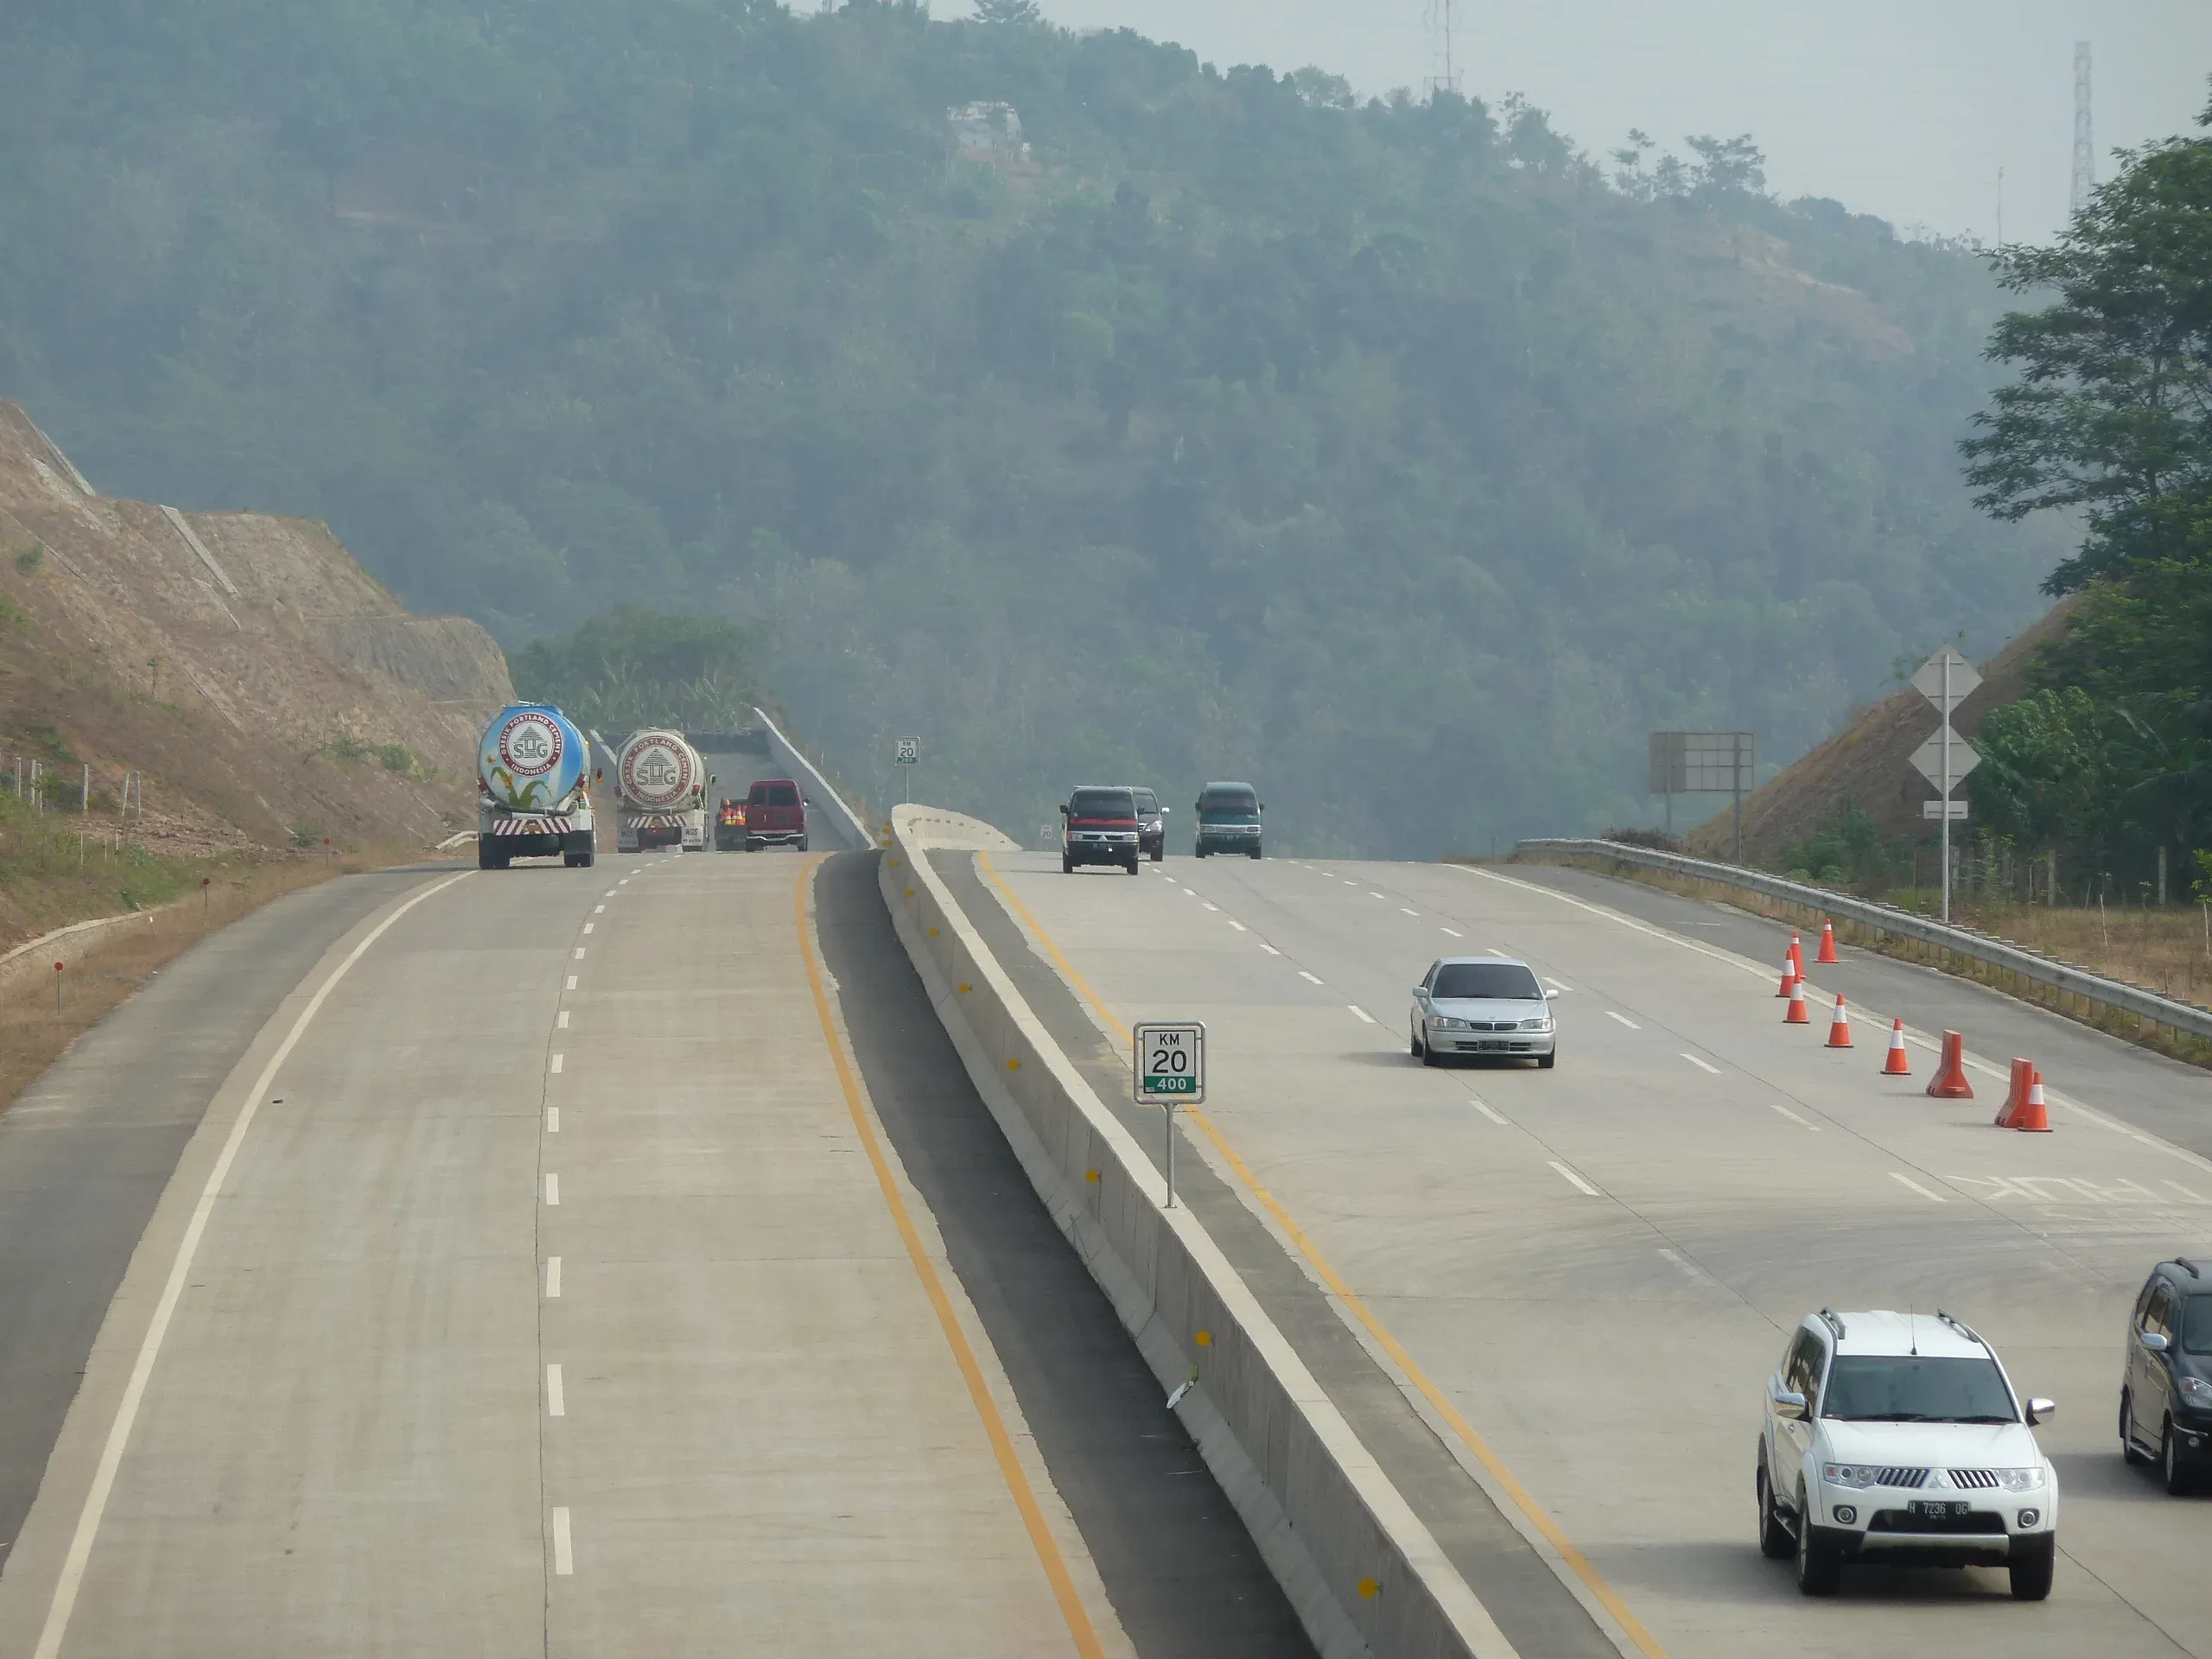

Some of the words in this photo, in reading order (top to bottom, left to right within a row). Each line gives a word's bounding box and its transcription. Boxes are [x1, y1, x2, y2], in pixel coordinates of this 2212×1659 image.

[509, 715, 549, 728] PORTLAND
[549, 724, 561, 753] CEMENT
[900, 747, 913, 757] 20
[633, 739, 677, 753] PORTLAND
[677, 753, 688, 783] CEMENT
[511, 763, 552, 775] INDONESIA
[636, 791, 677, 803] INDONESIA
[1160, 1033, 1179, 1046] KM
[1152, 1049, 1187, 1073] 20
[1157, 1077, 1186, 1090] 400
[1923, 1502, 1946, 1514] 7236
